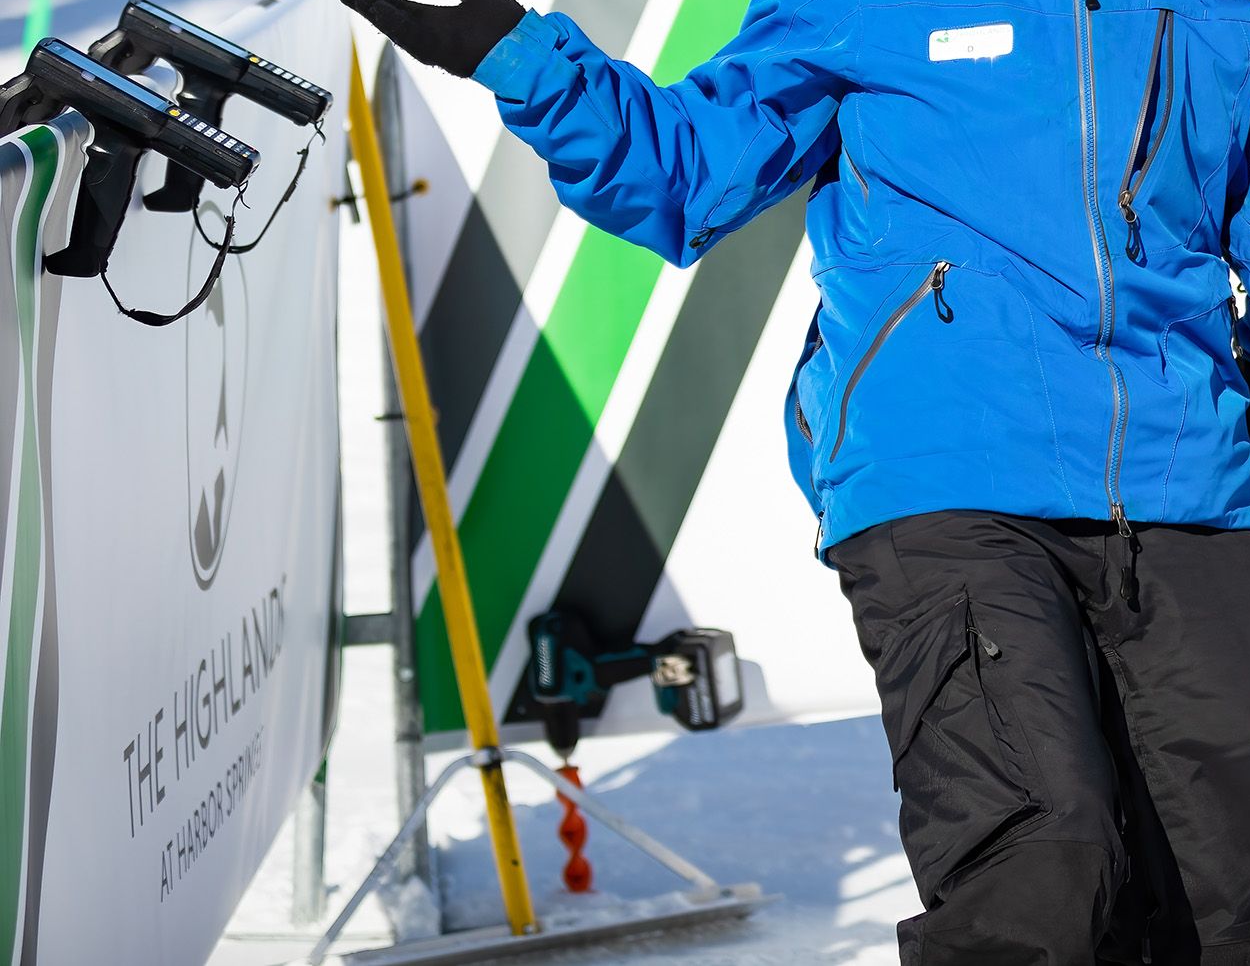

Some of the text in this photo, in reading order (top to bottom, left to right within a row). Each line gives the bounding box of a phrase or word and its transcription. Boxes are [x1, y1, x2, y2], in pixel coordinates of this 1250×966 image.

[123, 706, 166, 839] THE
[160, 839, 174, 903] AT
[175, 781, 225, 881] HARBOR
